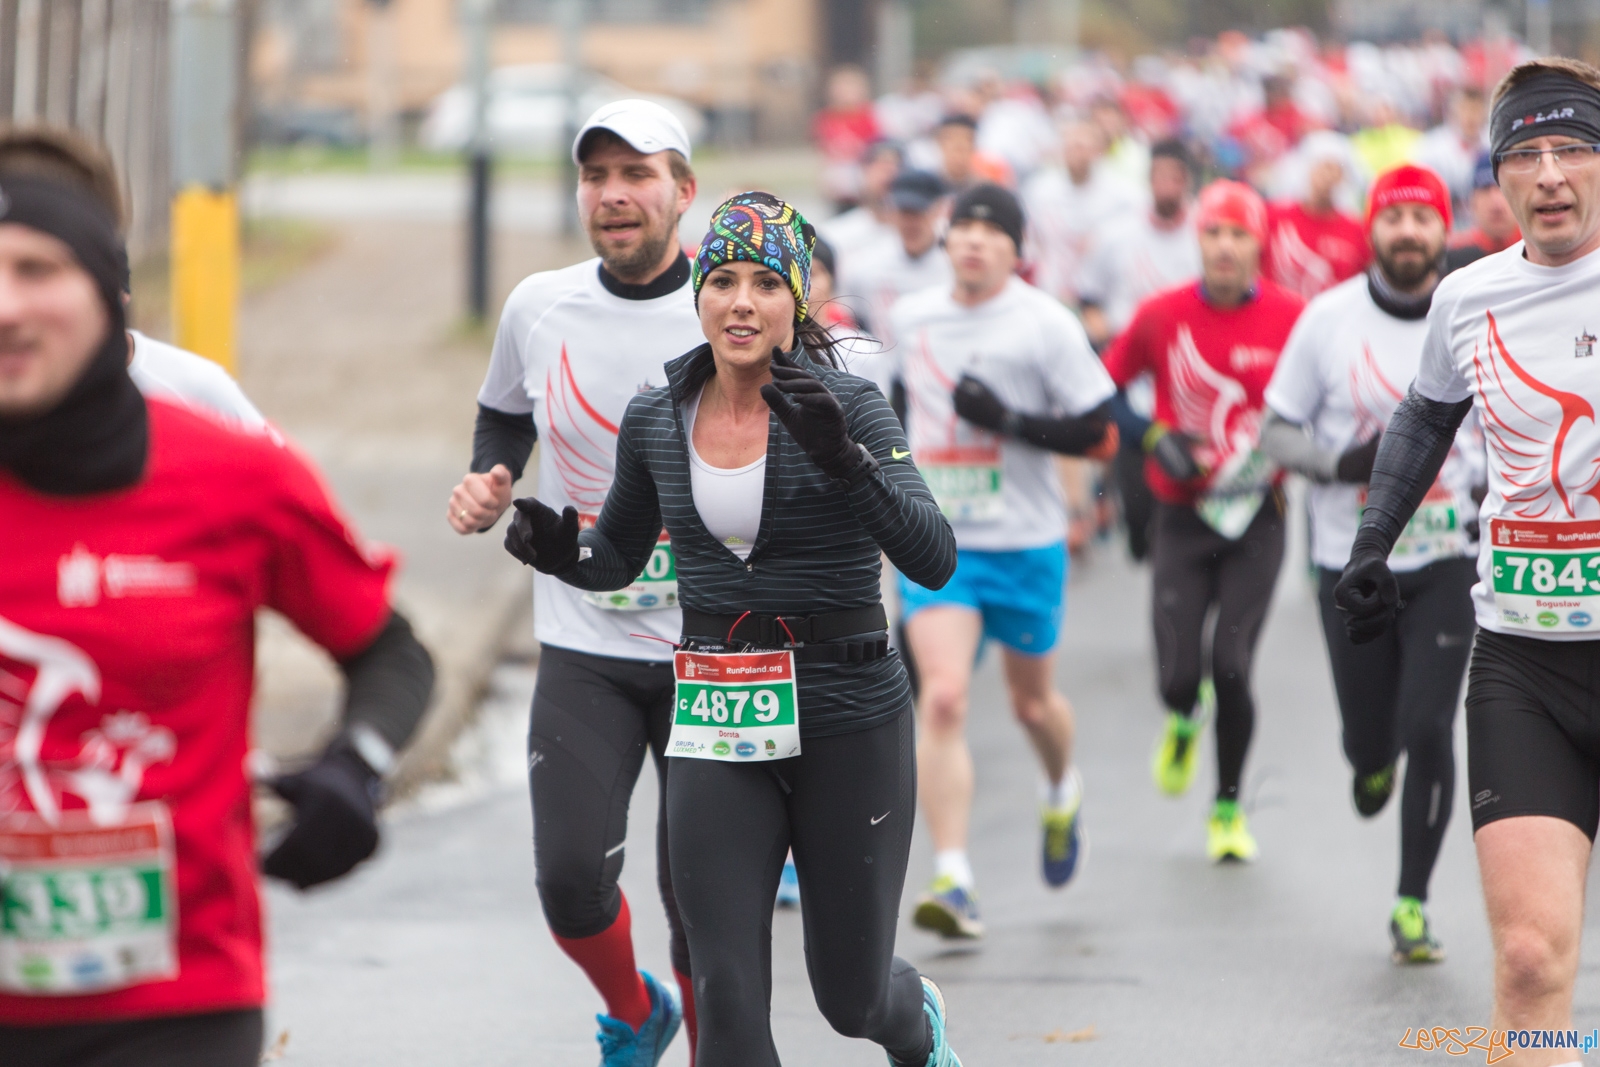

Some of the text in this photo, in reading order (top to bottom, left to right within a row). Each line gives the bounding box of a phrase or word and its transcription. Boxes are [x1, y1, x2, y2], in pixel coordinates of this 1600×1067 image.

[1511, 107, 1575, 131] POLAR
[726, 665, 783, 675] RunPoland.org
[690, 689, 780, 724] 4879
[718, 730, 740, 739] Dorota
[673, 746, 698, 754] LUXMED
